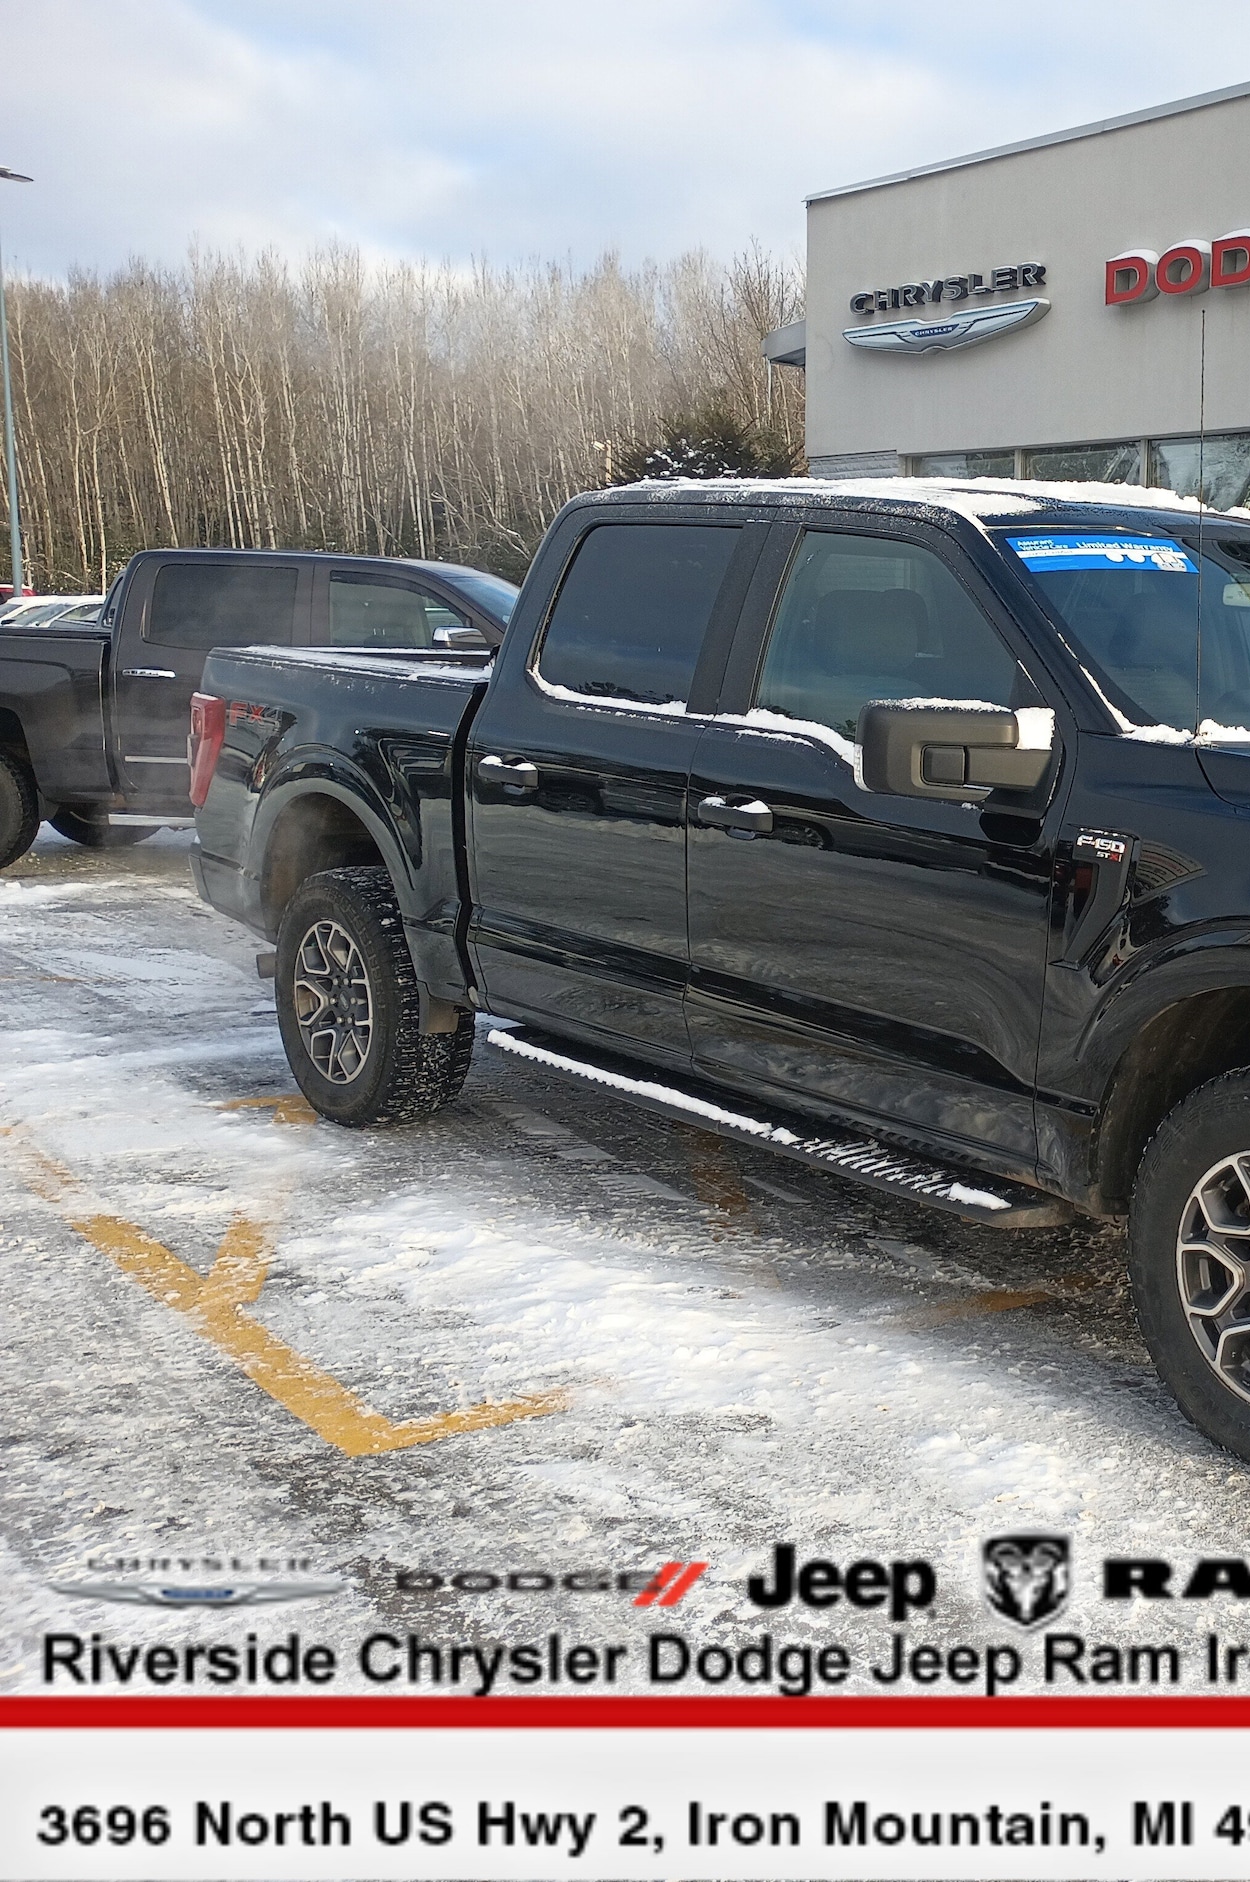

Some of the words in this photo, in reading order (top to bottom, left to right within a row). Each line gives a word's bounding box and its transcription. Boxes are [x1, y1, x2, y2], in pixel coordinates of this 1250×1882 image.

[850, 262, 1046, 315] CHRYSLER
[914, 327, 953, 337] CHRYSLER
[1076, 541, 1121, 550] Limited
[1121, 542, 1173, 553] Warranty
[229, 700, 283, 732] FX4
[1096, 851, 1122, 863] STX
